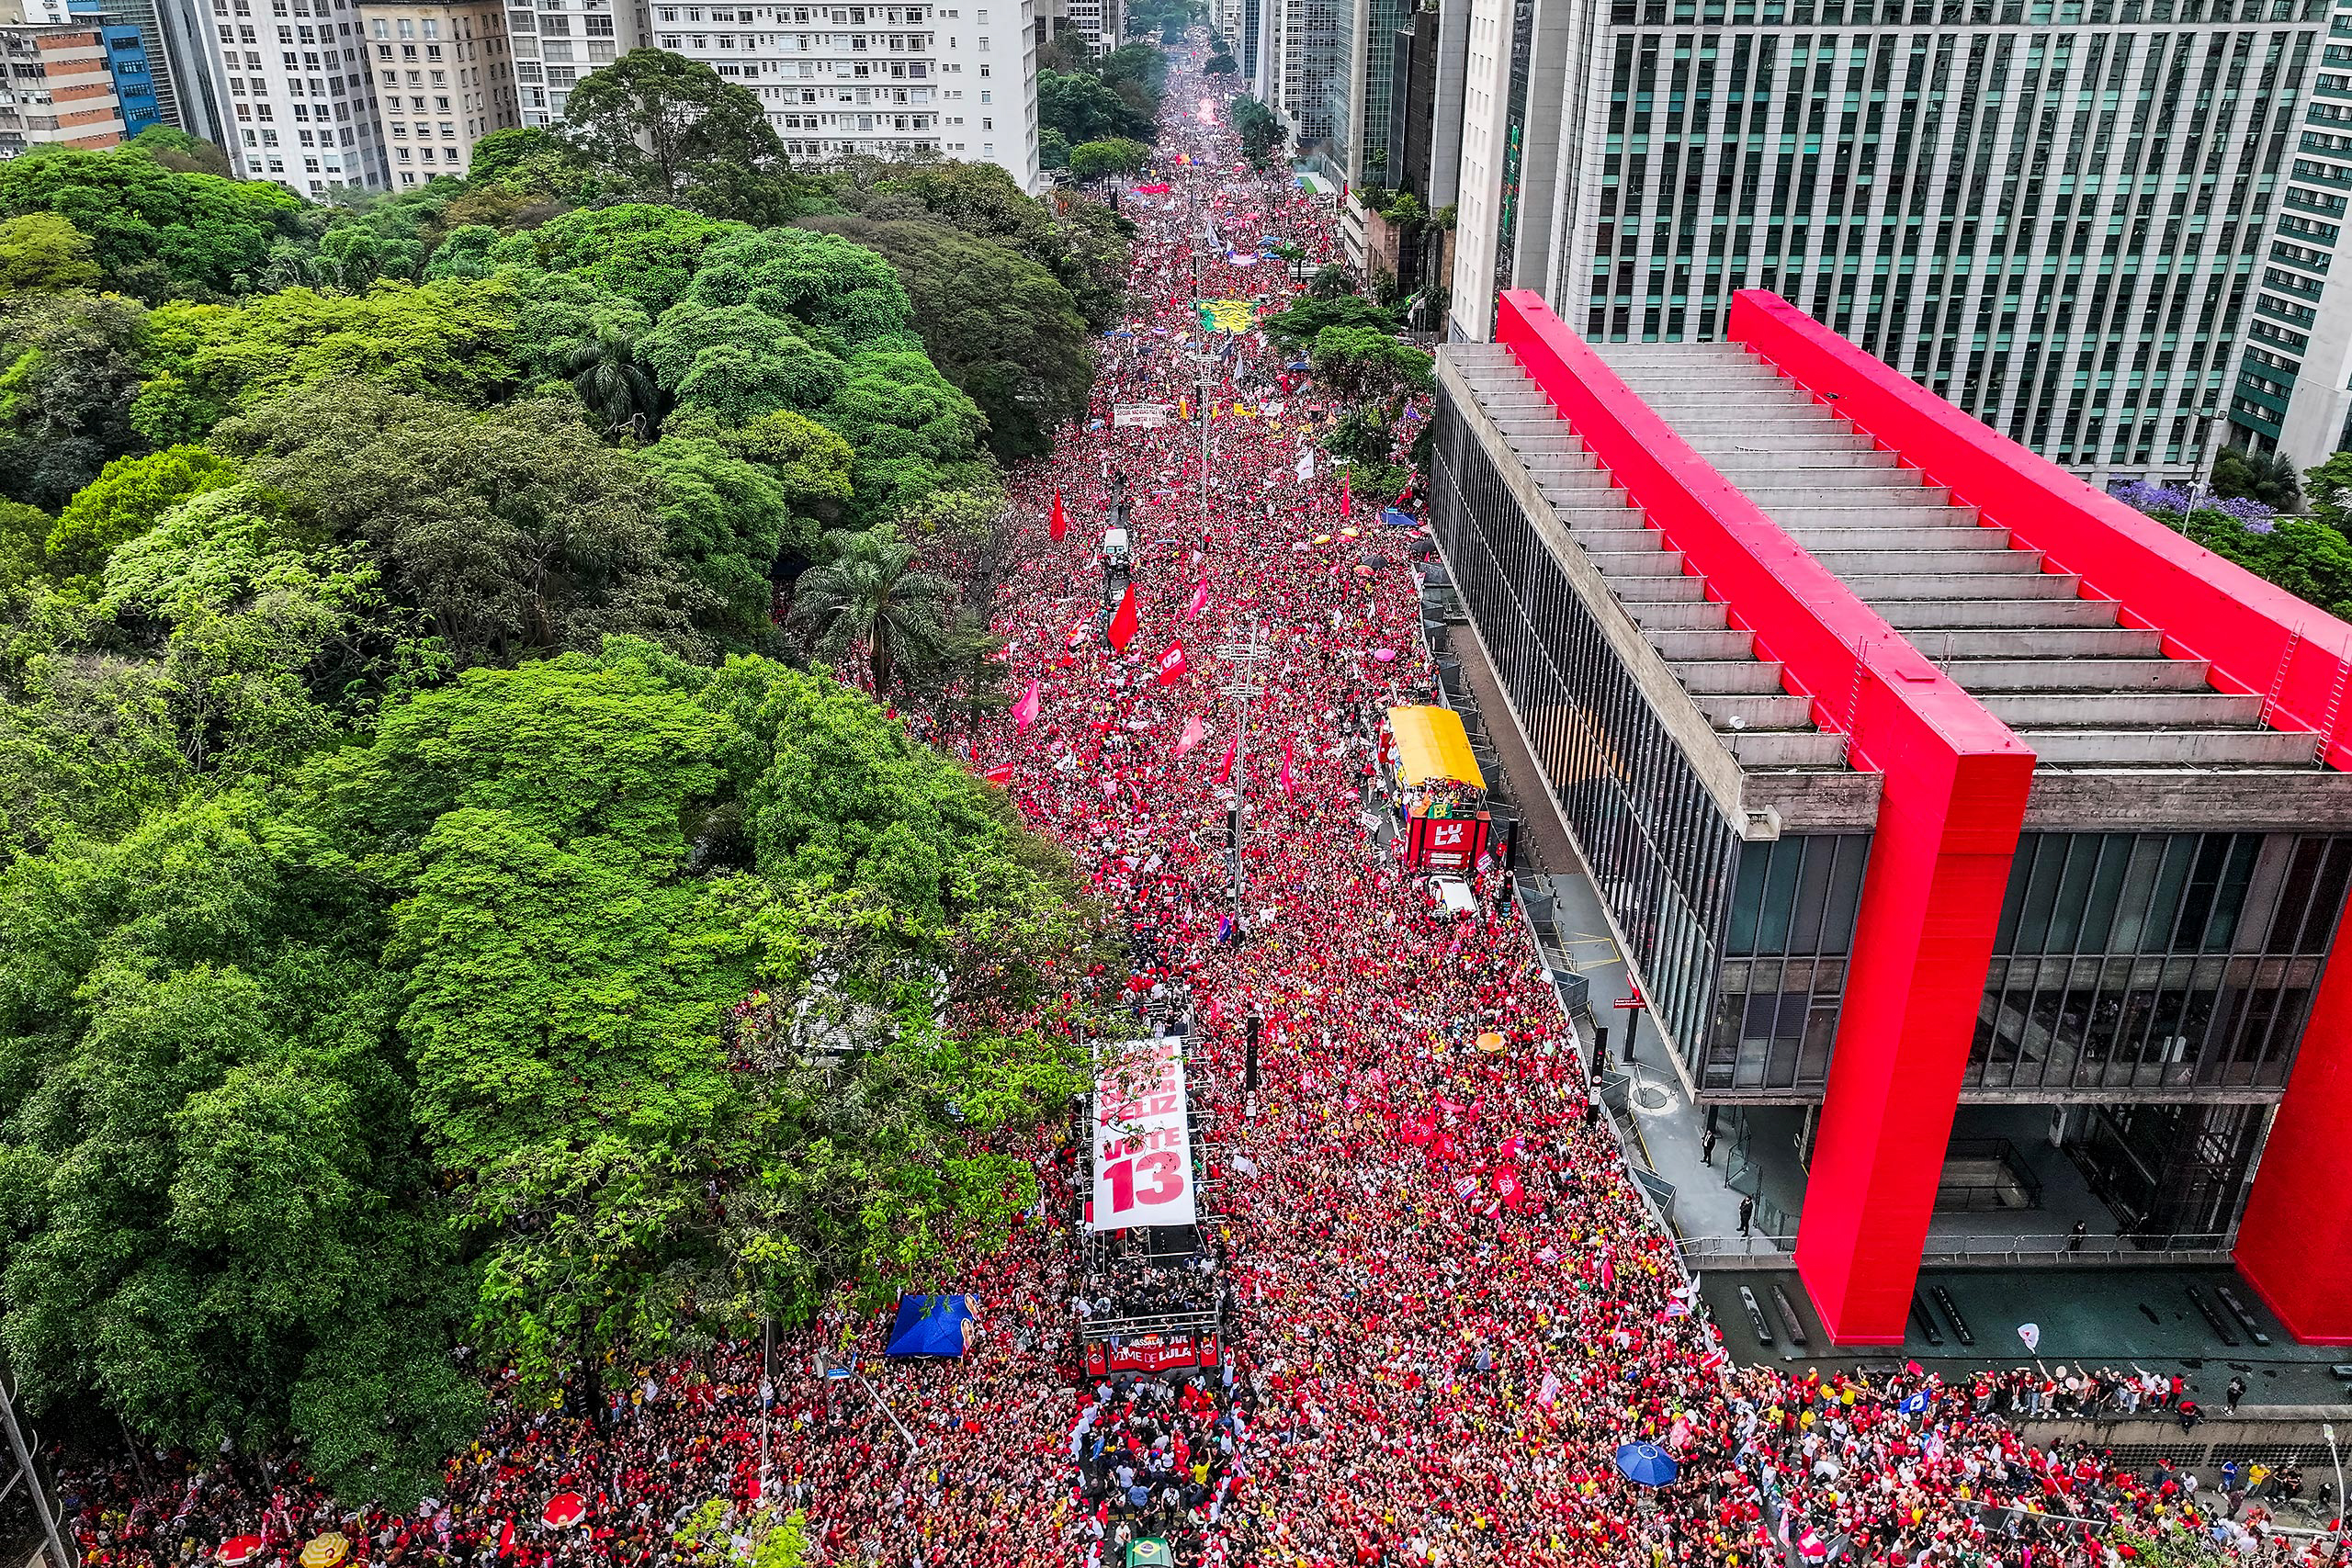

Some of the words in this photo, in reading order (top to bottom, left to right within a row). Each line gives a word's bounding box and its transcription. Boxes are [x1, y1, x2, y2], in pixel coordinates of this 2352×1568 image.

[1101, 1094, 1178, 1127] FELIZ
[1102, 1126, 1182, 1162] VOTE
[1102, 1151, 1184, 1213] 13
[1144, 1352, 1158, 1363] DE
[1159, 1347, 1193, 1361] LULA
